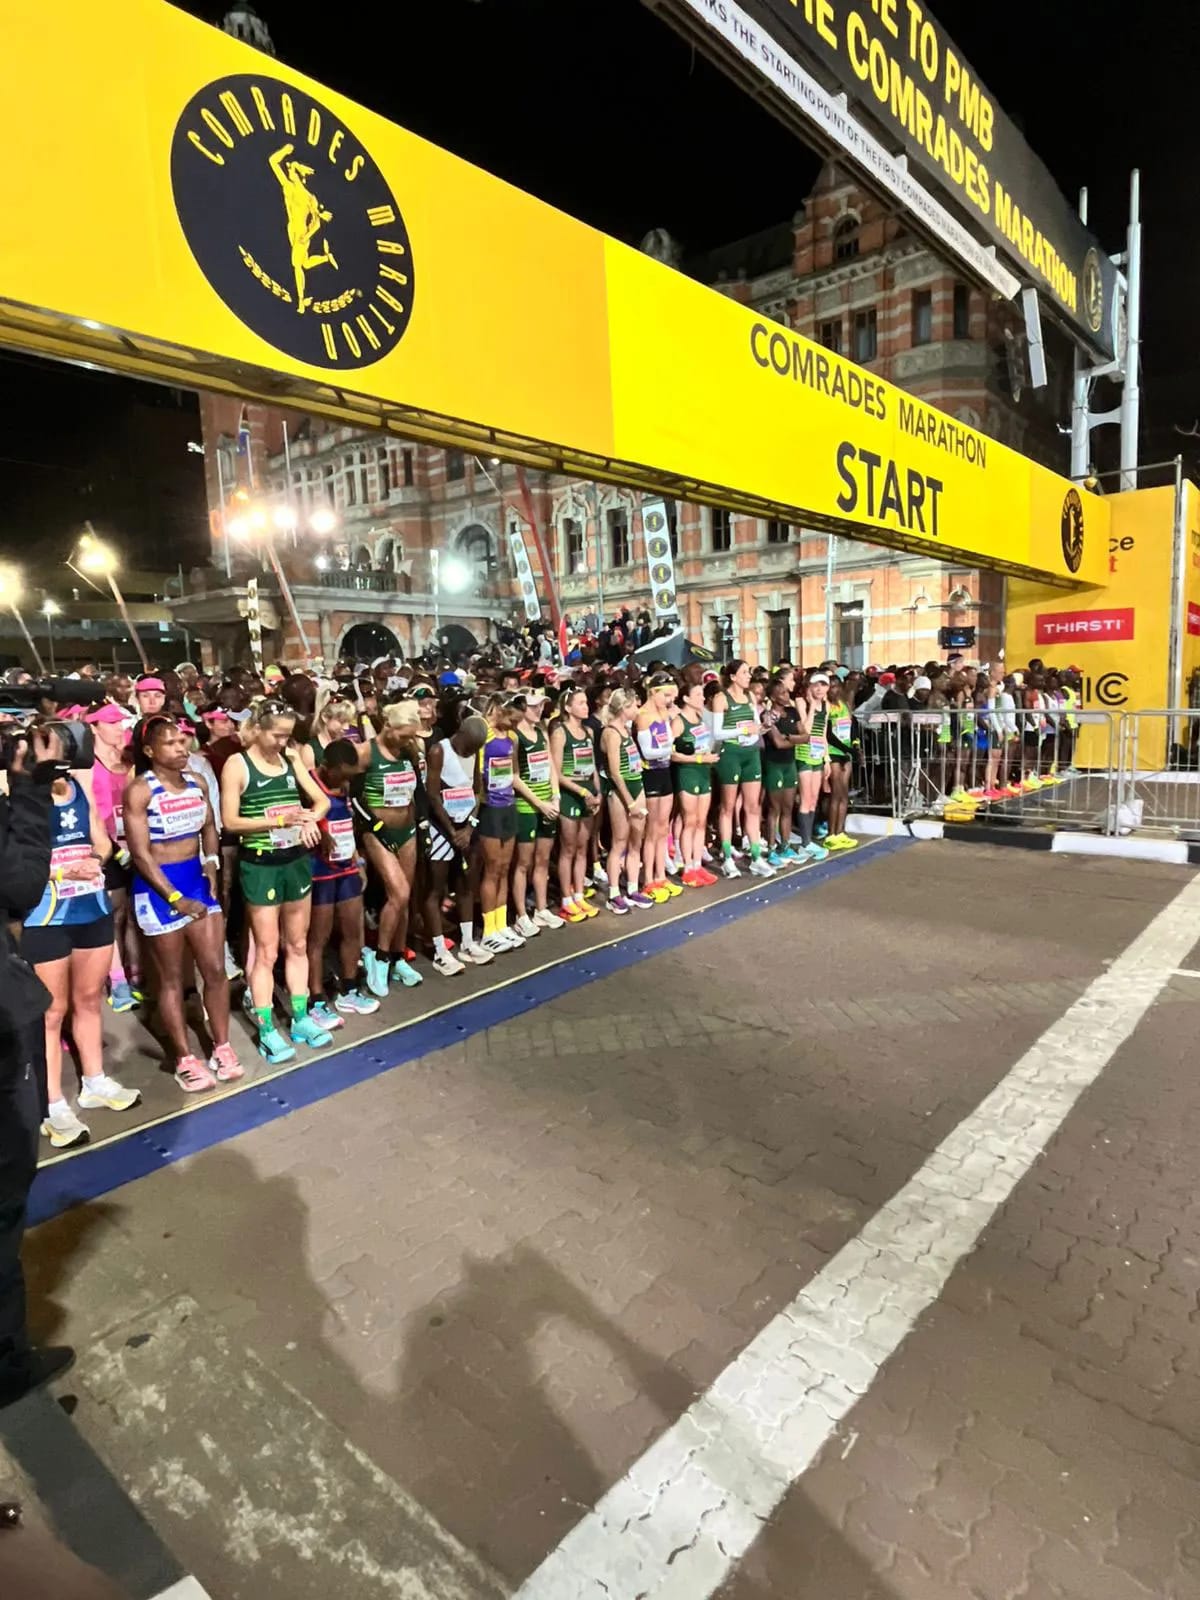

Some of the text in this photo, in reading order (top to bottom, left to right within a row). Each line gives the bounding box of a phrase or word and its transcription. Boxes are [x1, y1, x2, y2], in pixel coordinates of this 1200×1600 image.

[731, 13, 757, 52] THE
[761, 44, 815, 105] STARTING
[817, 98, 845, 132] POINT
[907, 0, 938, 82] TO
[945, 48, 994, 151] PMB
[187, 86, 407, 361] COMRADES MARATHON
[847, 11, 990, 214] COMRADES
[995, 181, 1076, 313] MARATHON
[750, 323, 986, 469] COMRADES MARATHON
[836, 441, 943, 536] START
[1043, 619, 1122, 635] THIRSTI
